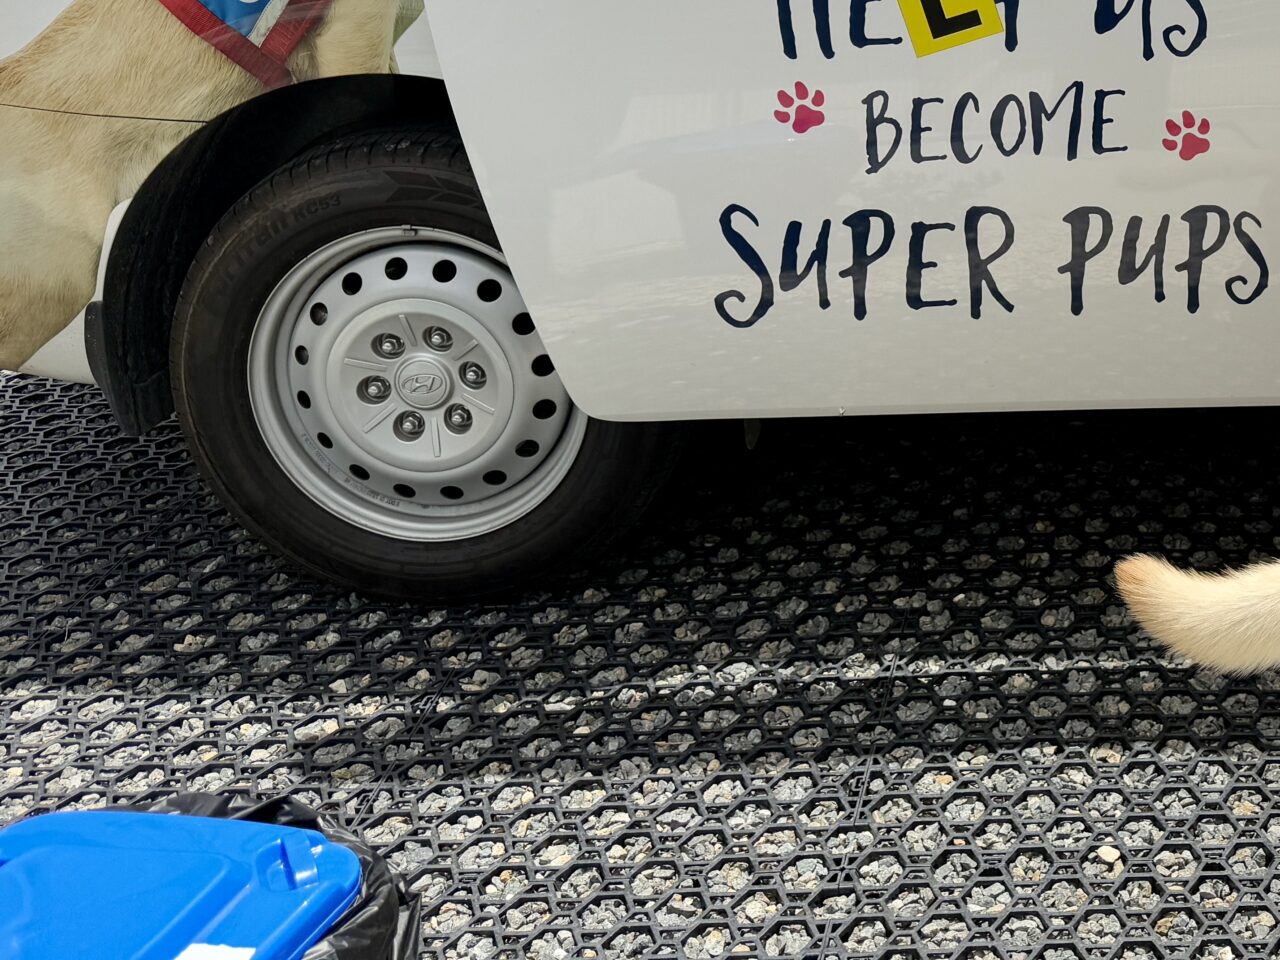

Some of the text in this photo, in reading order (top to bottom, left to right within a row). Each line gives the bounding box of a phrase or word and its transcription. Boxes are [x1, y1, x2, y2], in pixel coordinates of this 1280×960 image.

[862, 81, 1128, 175] BECOME
[714, 204, 1269, 328] SUPER PUPS
